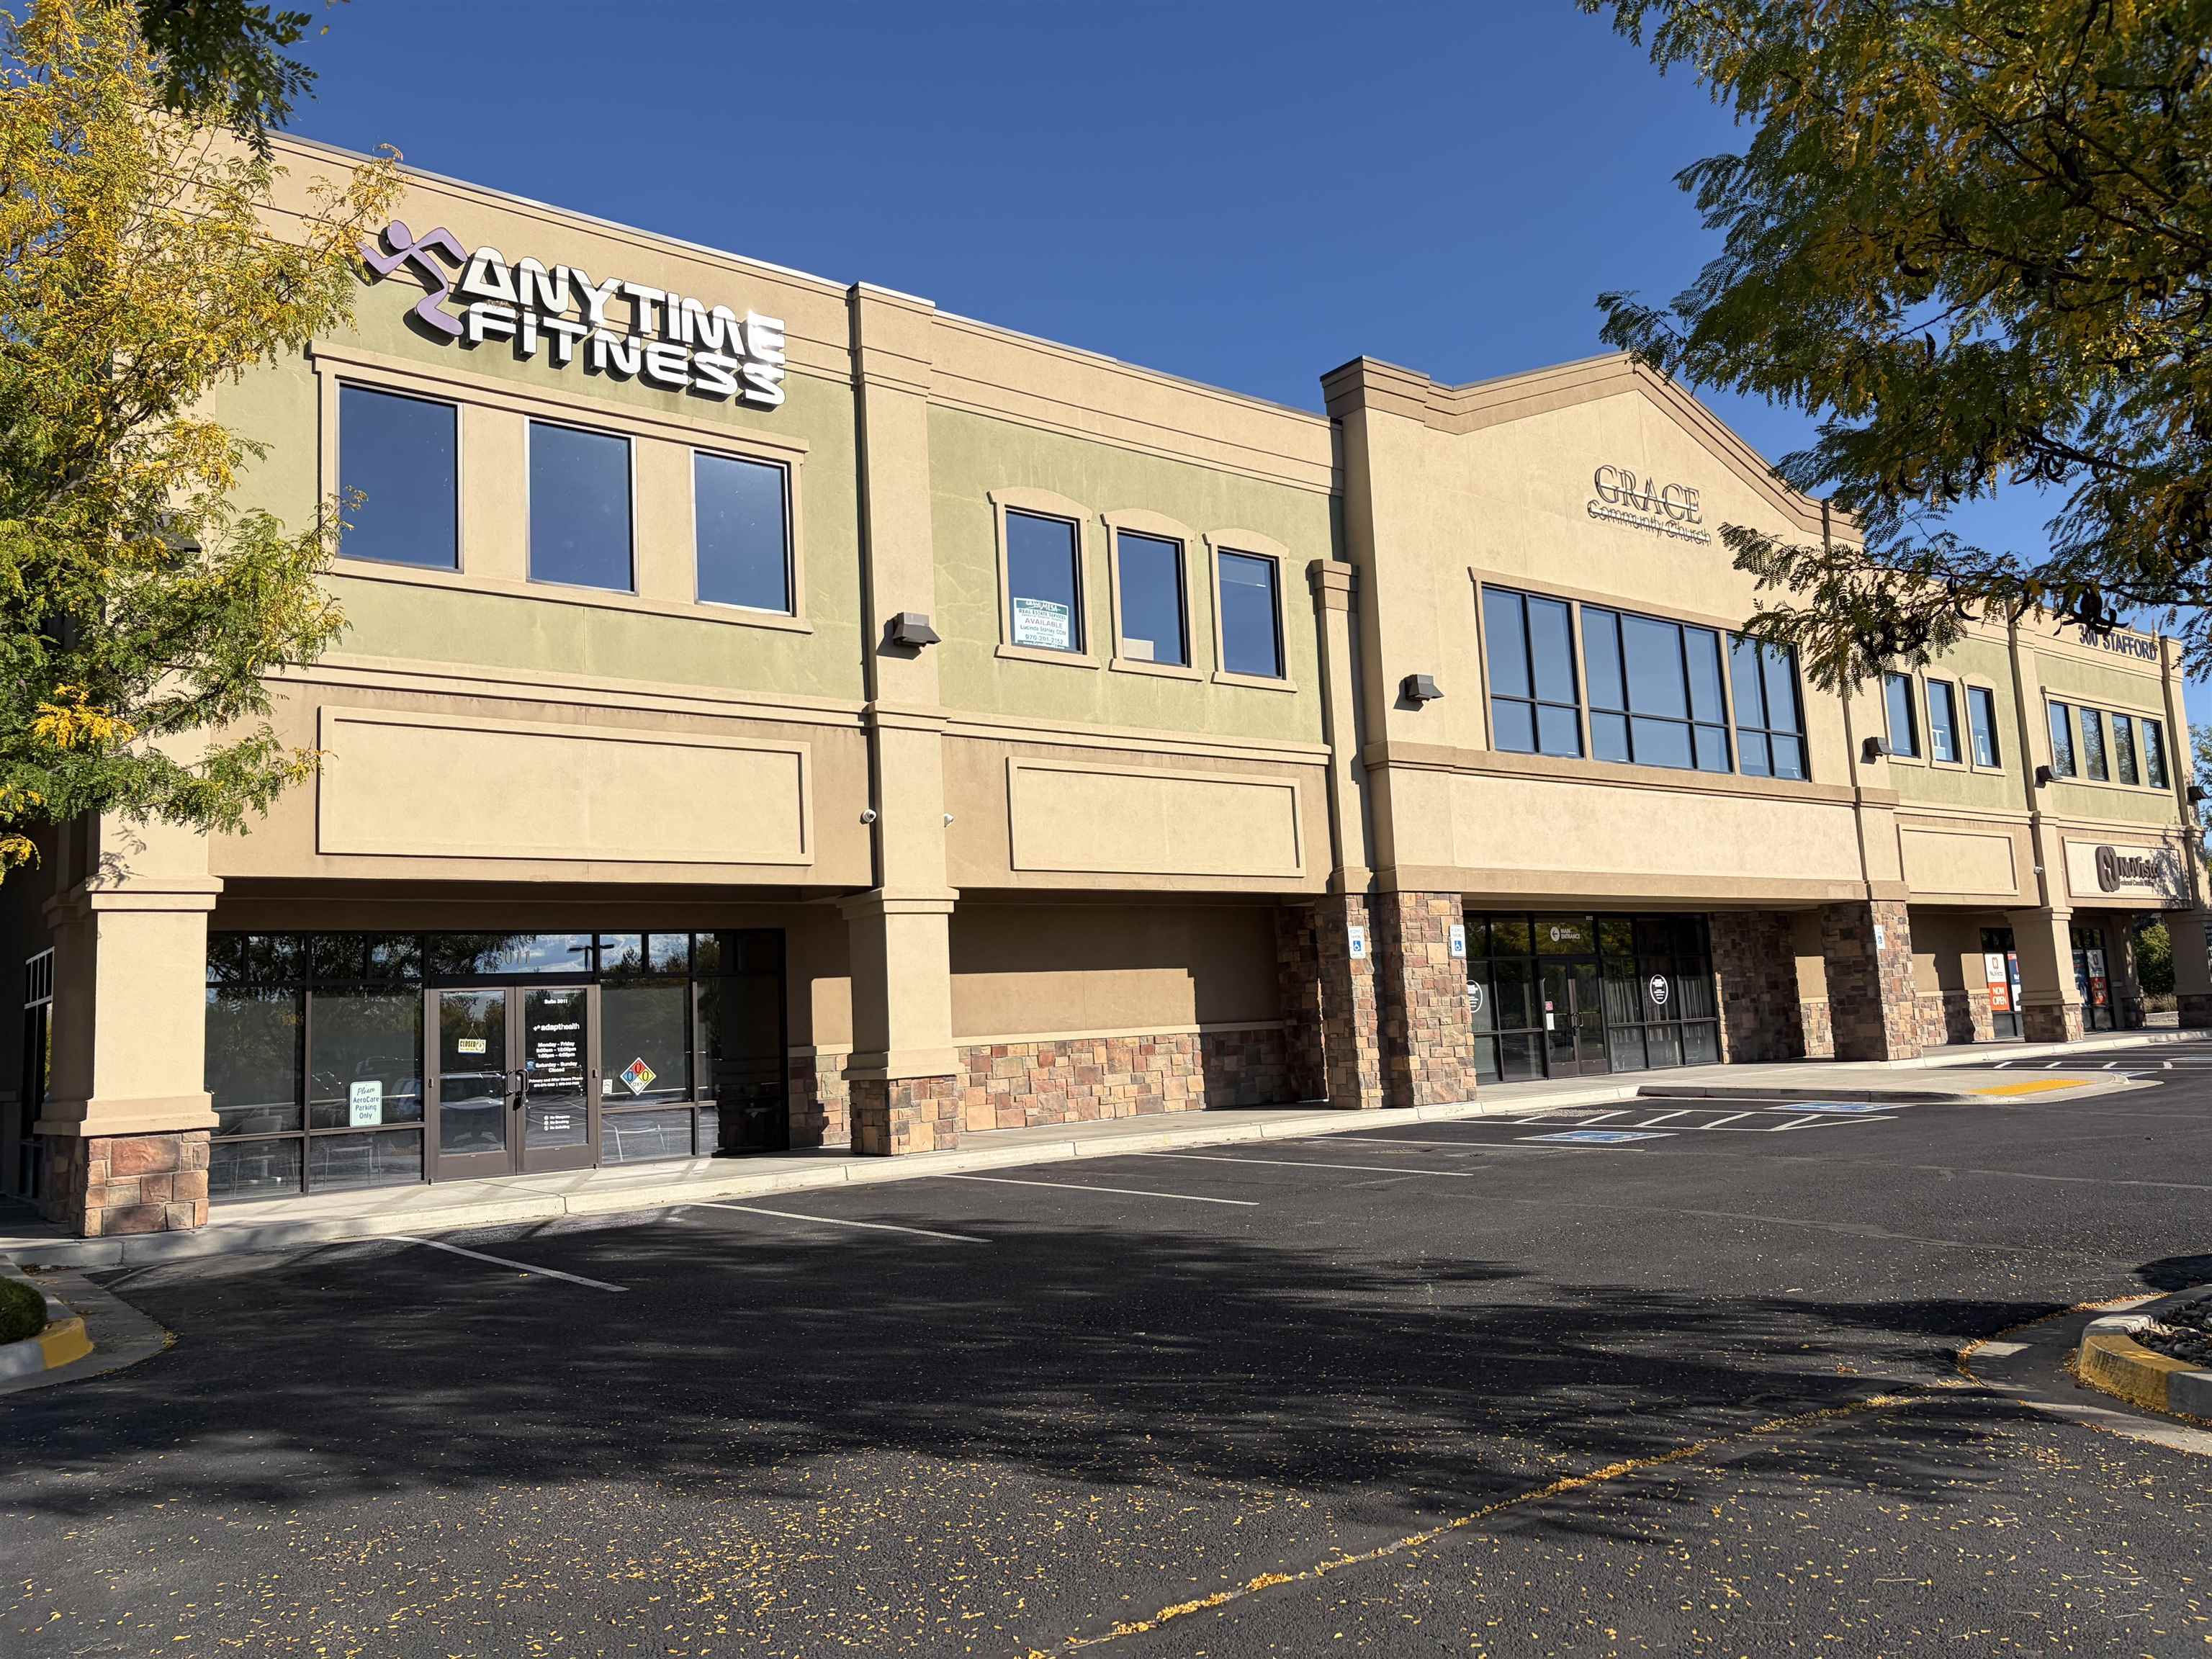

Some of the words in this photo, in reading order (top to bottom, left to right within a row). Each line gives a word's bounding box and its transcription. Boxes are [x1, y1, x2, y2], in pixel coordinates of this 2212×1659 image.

[461, 246, 786, 364] ANYTIME
[467, 301, 786, 408] FITNESS
[1594, 464, 1702, 525] GRACE
[1587, 499, 1664, 539] Community
[1665, 519, 1711, 547] Church
[1025, 618, 1064, 629] AVAILABLE
[2102, 631, 2158, 661] STAFFORD
[1992, 997, 2007, 1005] OPEN
[541, 1022, 580, 1031] adapthealth
[635, 1063, 642, 1074] 0
[627, 1071, 634, 1082] 0
[642, 1071, 649, 1082] 0
